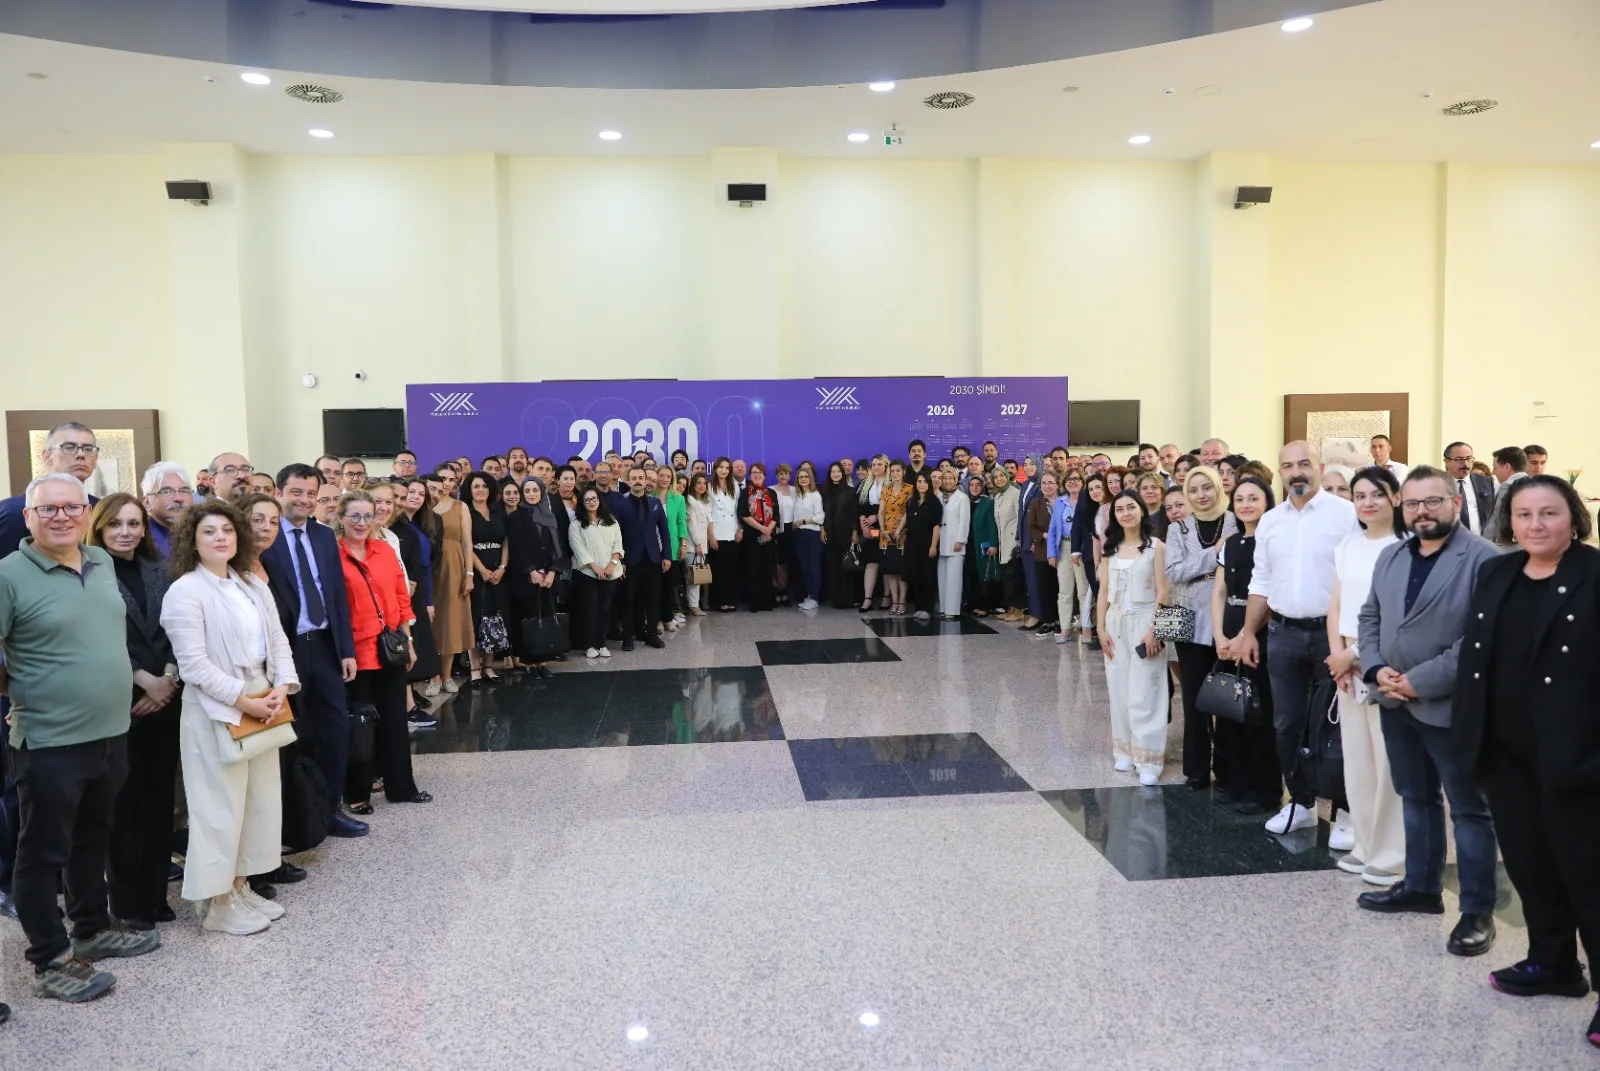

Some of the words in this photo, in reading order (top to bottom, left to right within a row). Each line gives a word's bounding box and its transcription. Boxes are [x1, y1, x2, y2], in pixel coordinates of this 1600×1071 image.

[950, 385, 974, 395] 2030
[976, 384, 1006, 396] ŞİMDİ!
[926, 405, 955, 416] 2026
[1000, 404, 1028, 415] 2027
[569, 418, 698, 465] 2030
